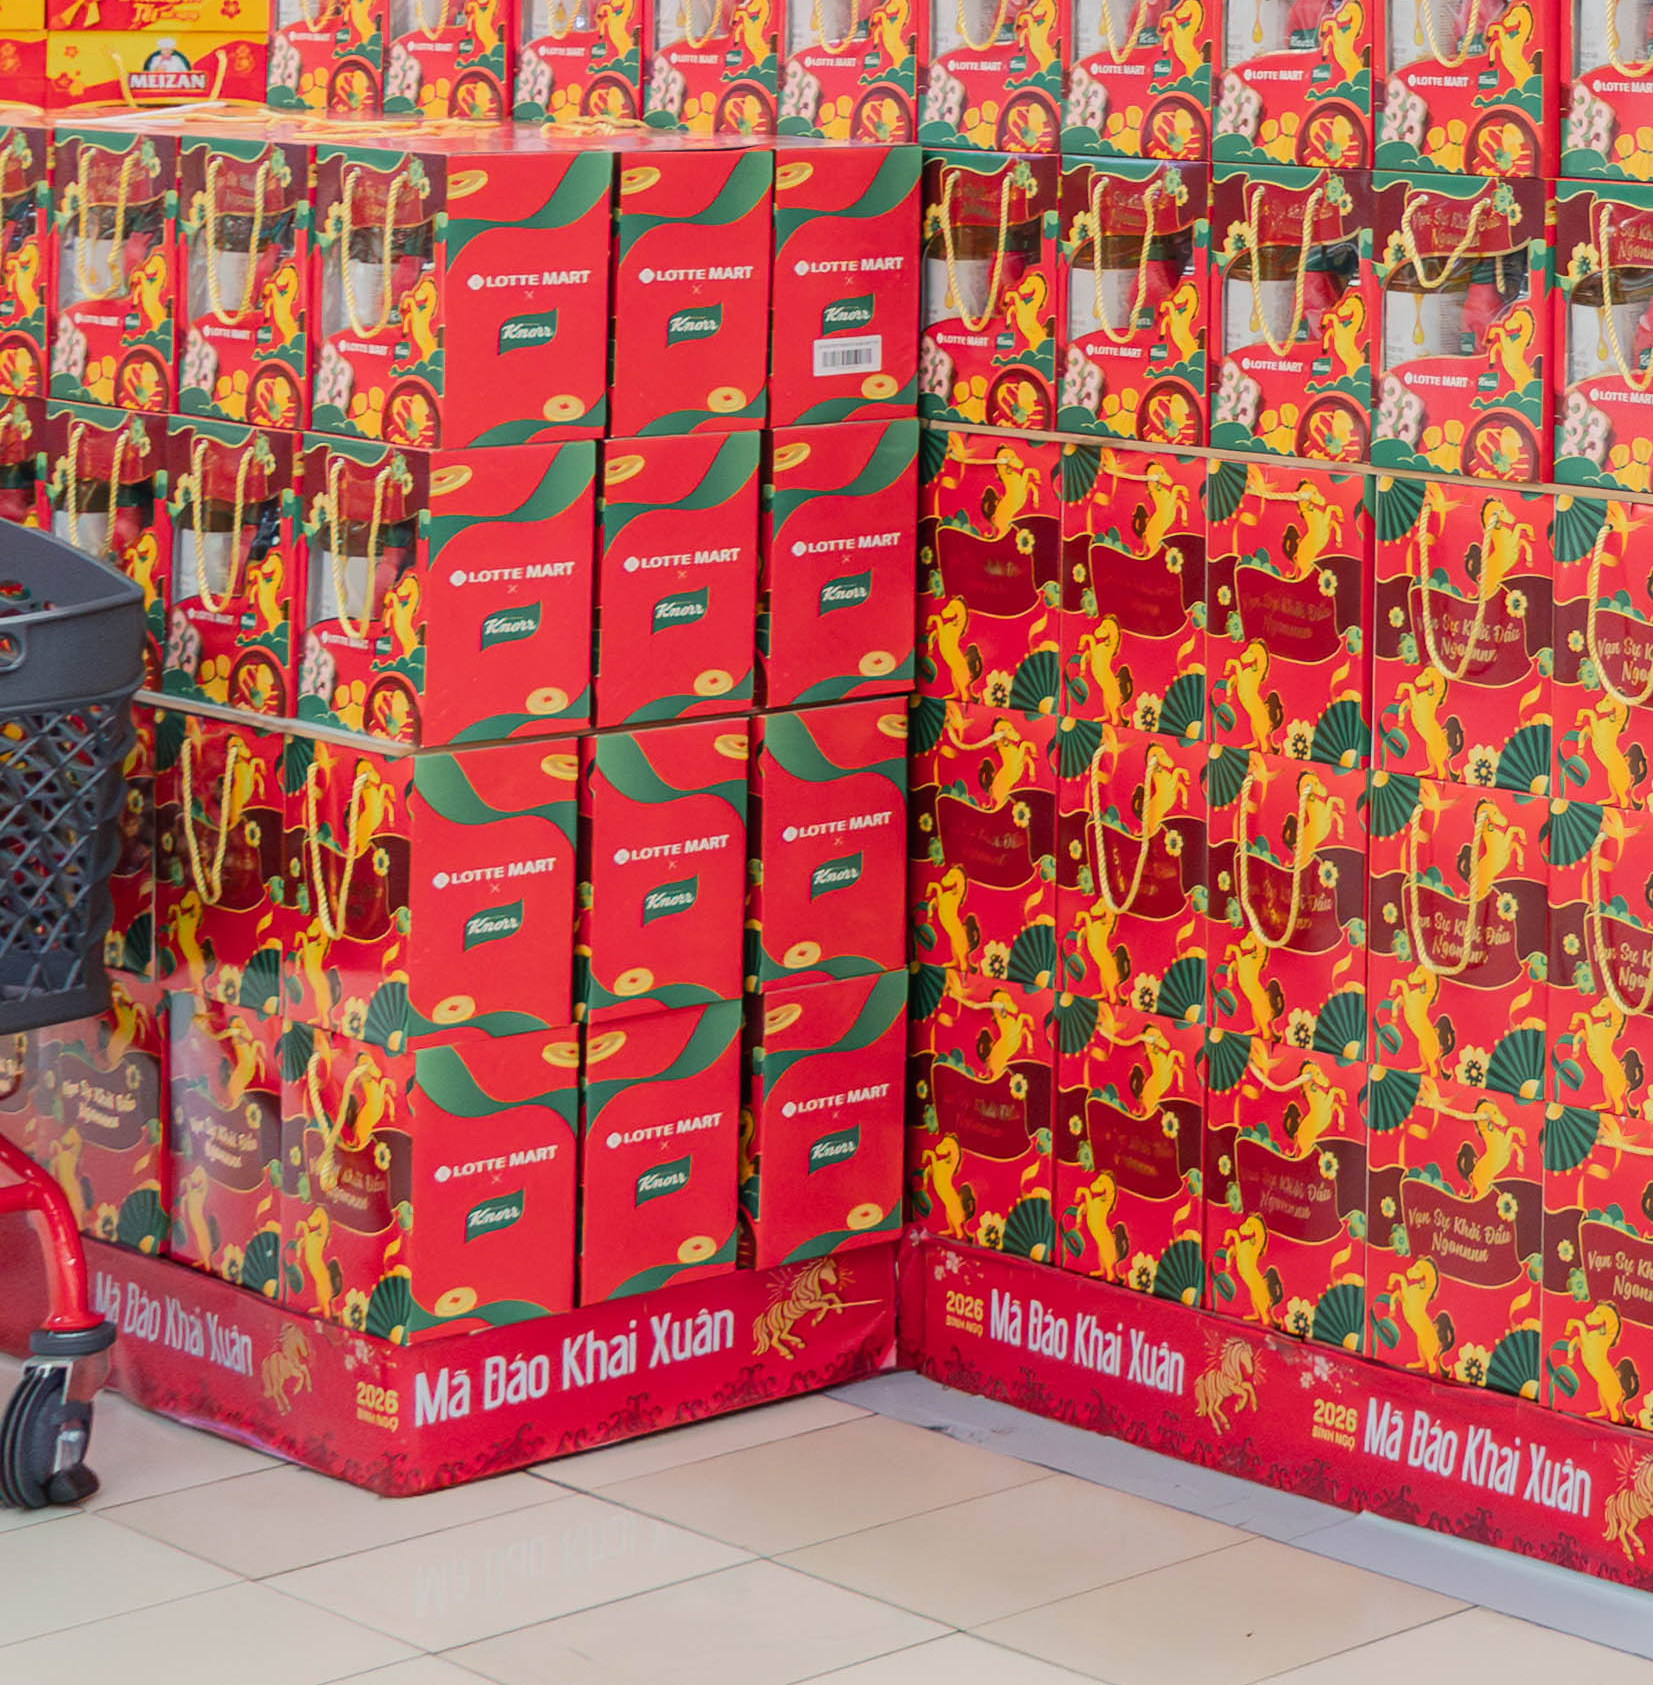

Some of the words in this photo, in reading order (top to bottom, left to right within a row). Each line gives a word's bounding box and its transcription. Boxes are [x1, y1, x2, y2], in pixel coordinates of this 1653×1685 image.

[486, 274, 538, 287] LOTTE
[543, 270, 590, 284] MART
[502, 324, 554, 339] Knorr
[623, 1124, 672, 1147] LOTTE
[677, 1113, 722, 1133] MART
[639, 1173, 687, 1192] Knorr
[415, 1368, 470, 1427] Mã
[484, 1354, 549, 1410] Đáo
[563, 1330, 636, 1389] Khai
[649, 1309, 734, 1368] Xuân
[357, 1382, 398, 1414] 2026
[1314, 1399, 1357, 1432] 2026
[1364, 1398, 1404, 1461] Mã
[1408, 1416, 1458, 1477] Đáo
[1462, 1426, 1520, 1495] Khai
[1524, 1443, 1591, 1517] Xuân
